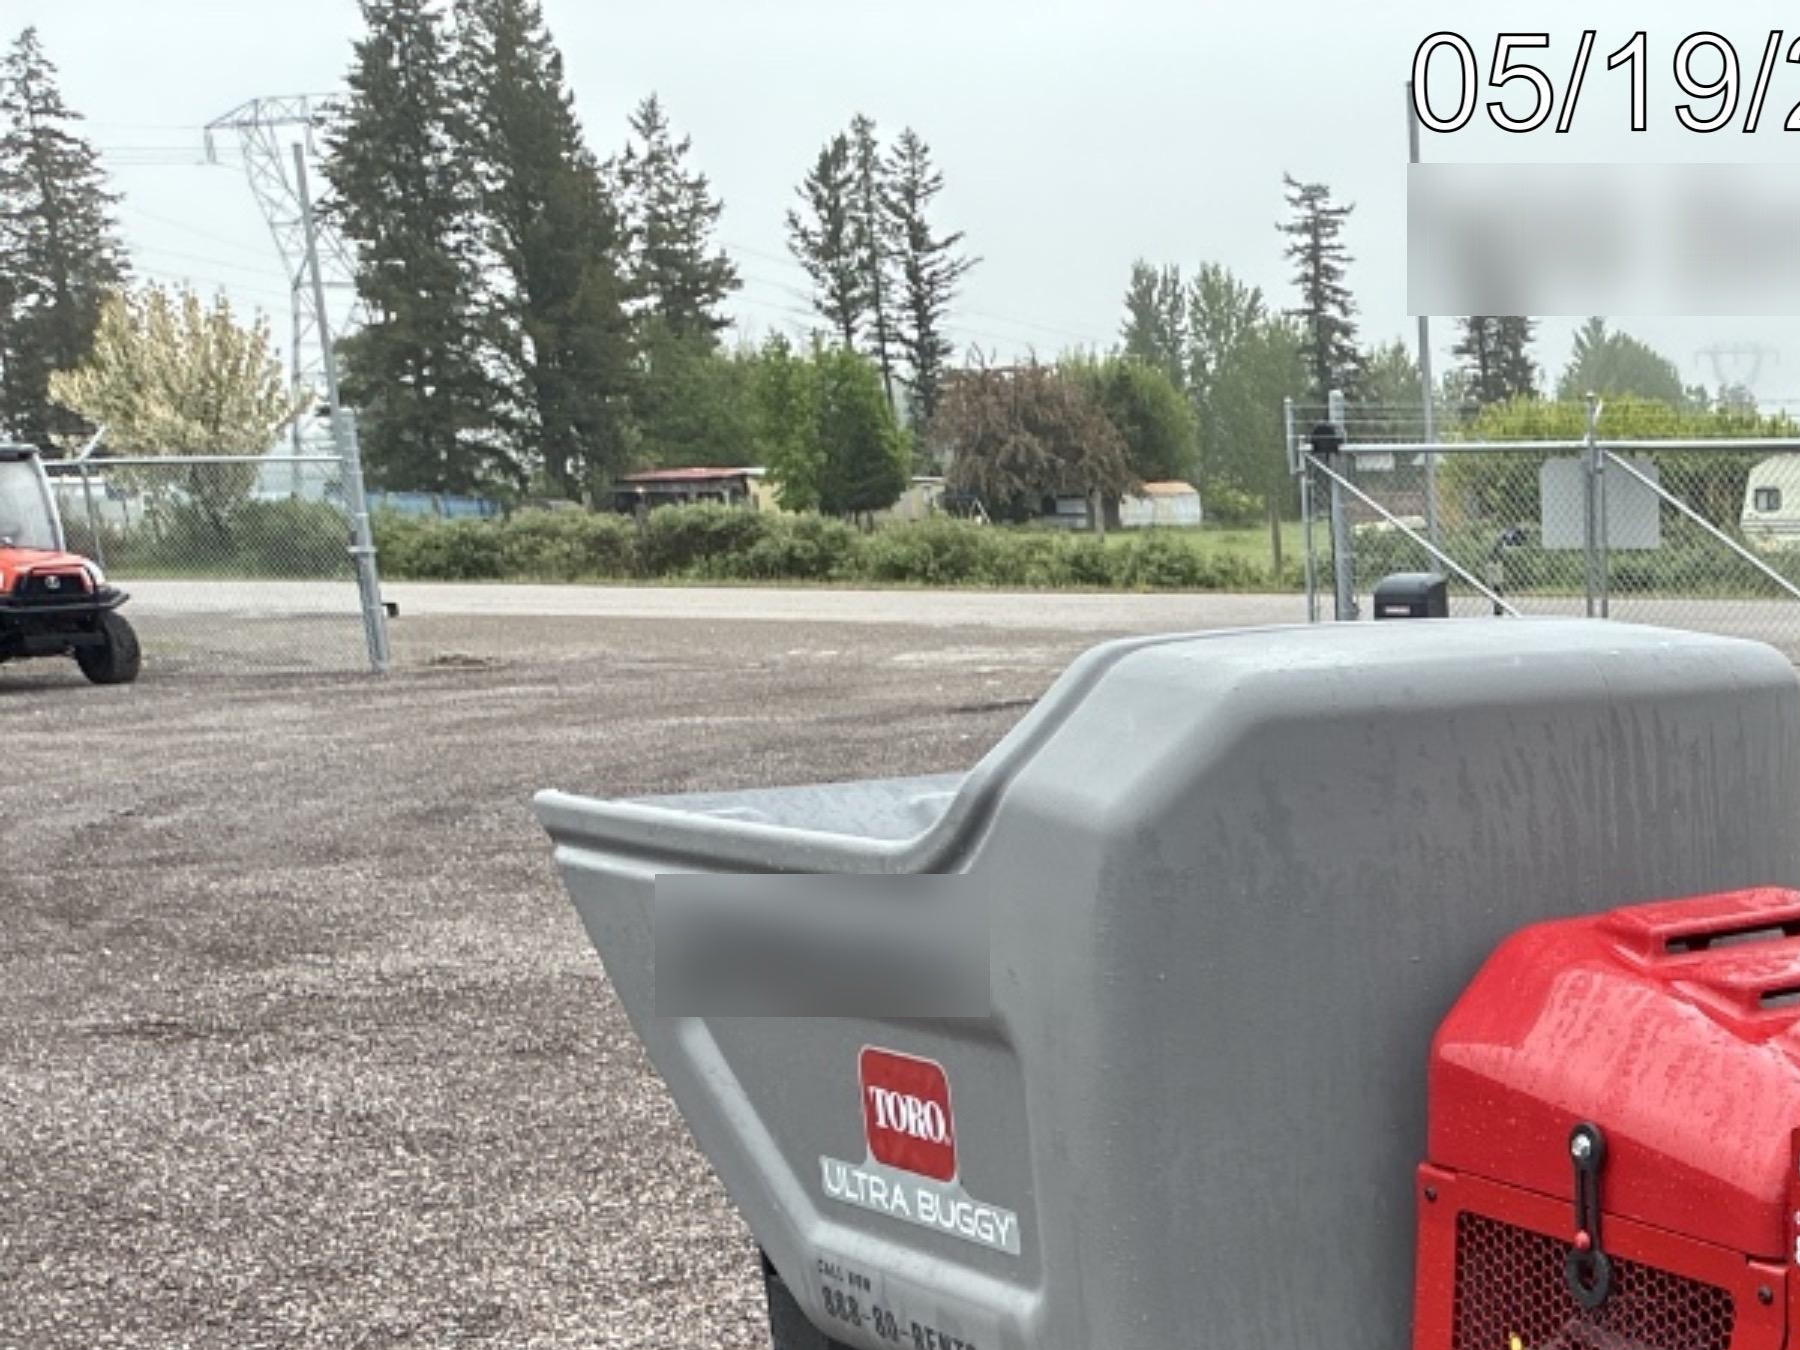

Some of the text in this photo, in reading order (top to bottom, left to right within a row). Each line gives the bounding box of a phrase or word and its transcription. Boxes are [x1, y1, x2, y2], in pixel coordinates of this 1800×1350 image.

[867, 1085, 947, 1144] TORO
[823, 1160, 1010, 1246] ULTRA BUGGY
